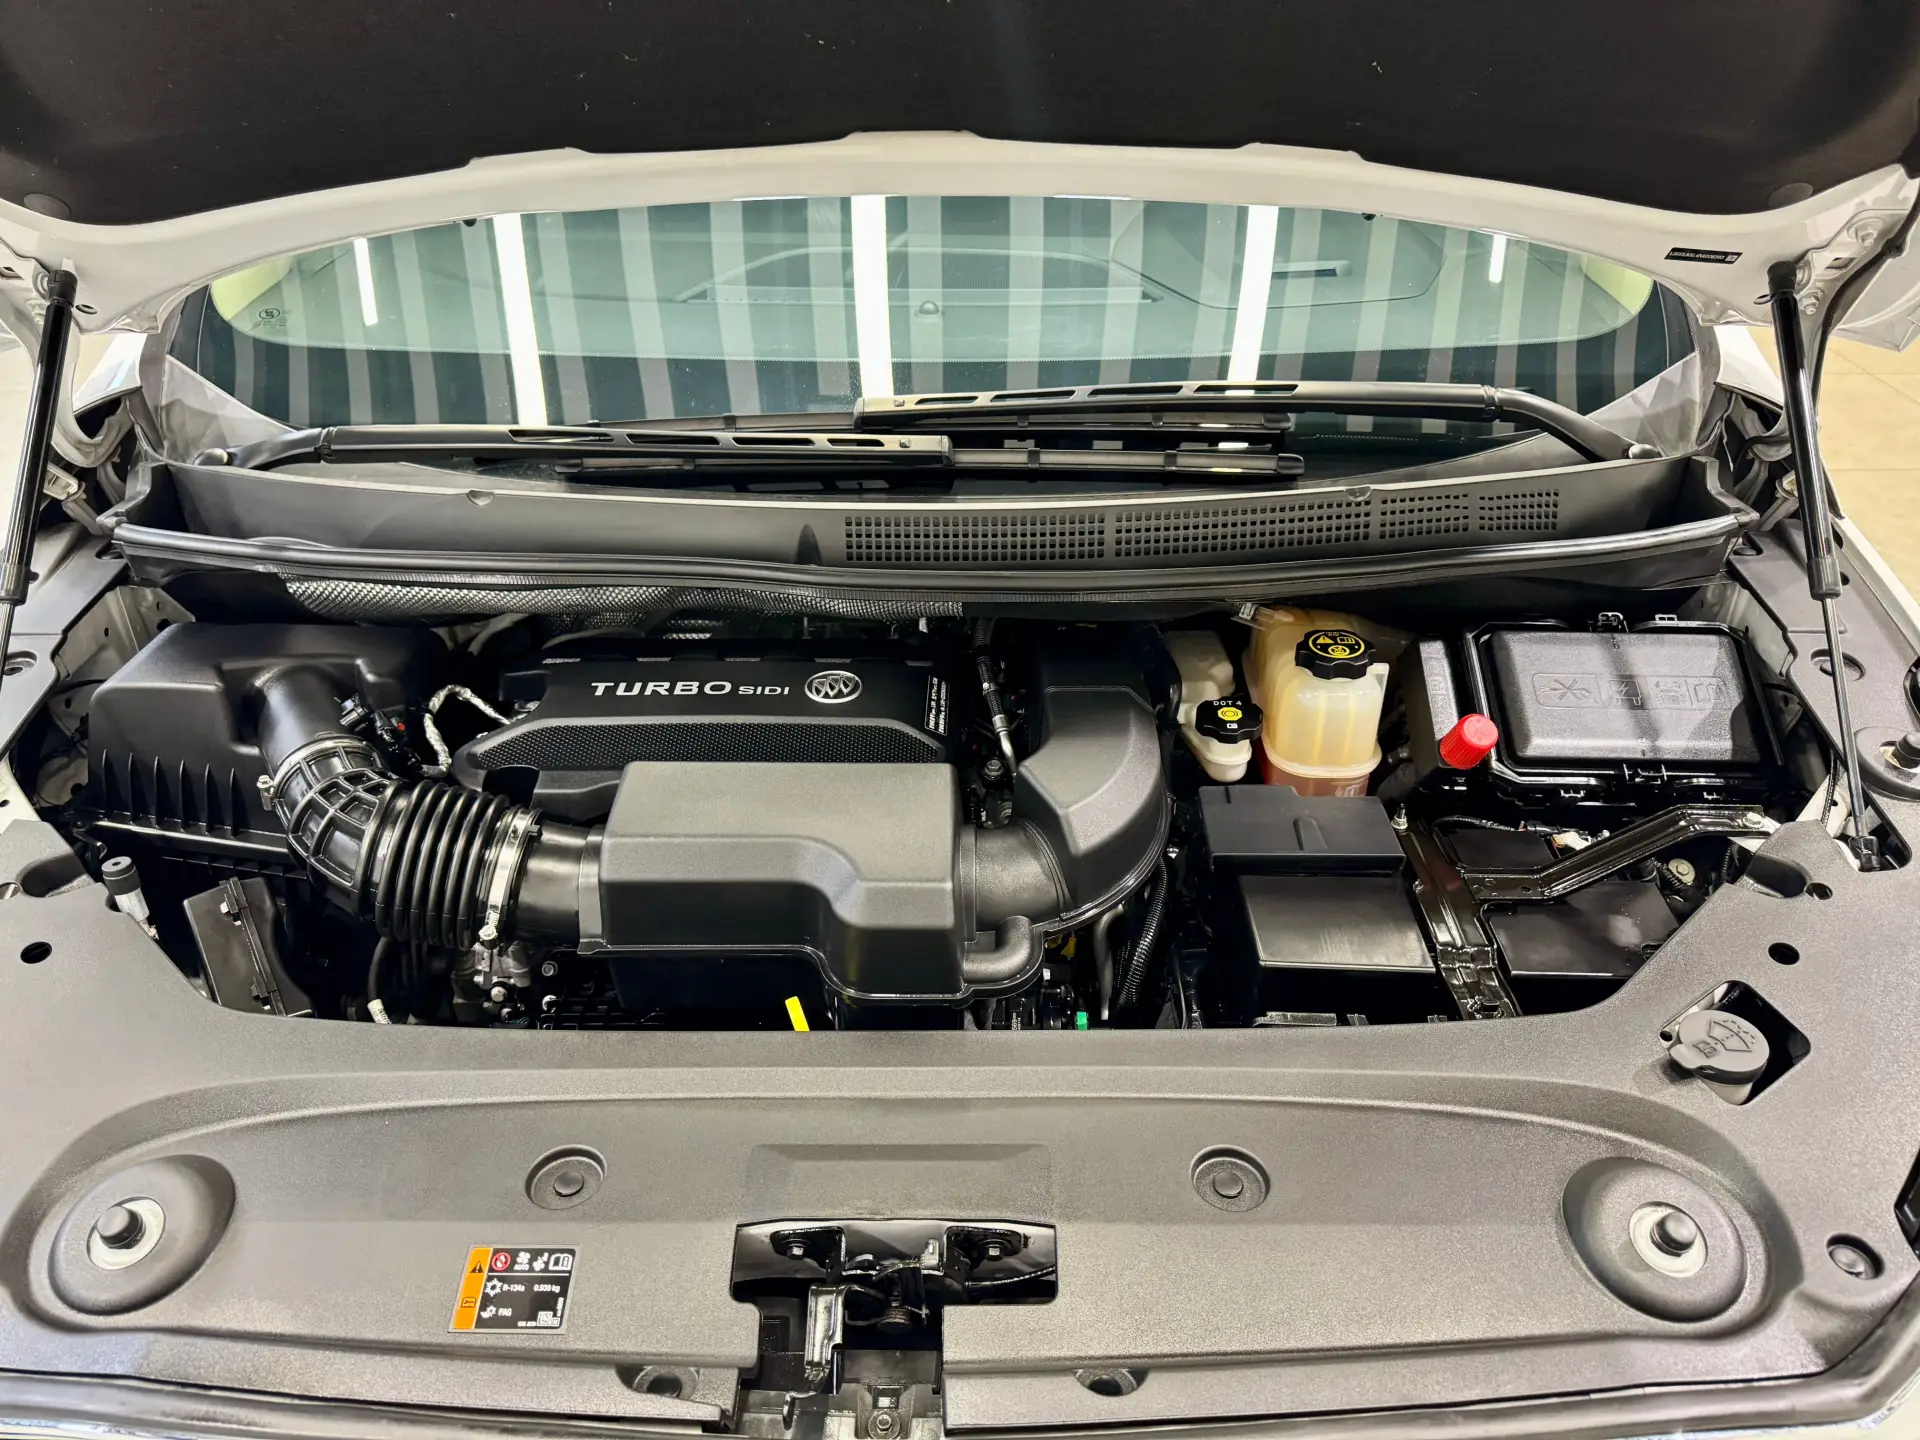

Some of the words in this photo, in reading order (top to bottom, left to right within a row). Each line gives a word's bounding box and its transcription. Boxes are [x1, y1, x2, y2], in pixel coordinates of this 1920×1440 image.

[590, 681, 733, 696] TURBO
[737, 685, 790, 696] SIDI
[513, 1263, 530, 1271] AUTO
[502, 1283, 525, 1292] R-134a
[552, 1284, 561, 1293] kg
[498, 1307, 512, 1317] PAG
